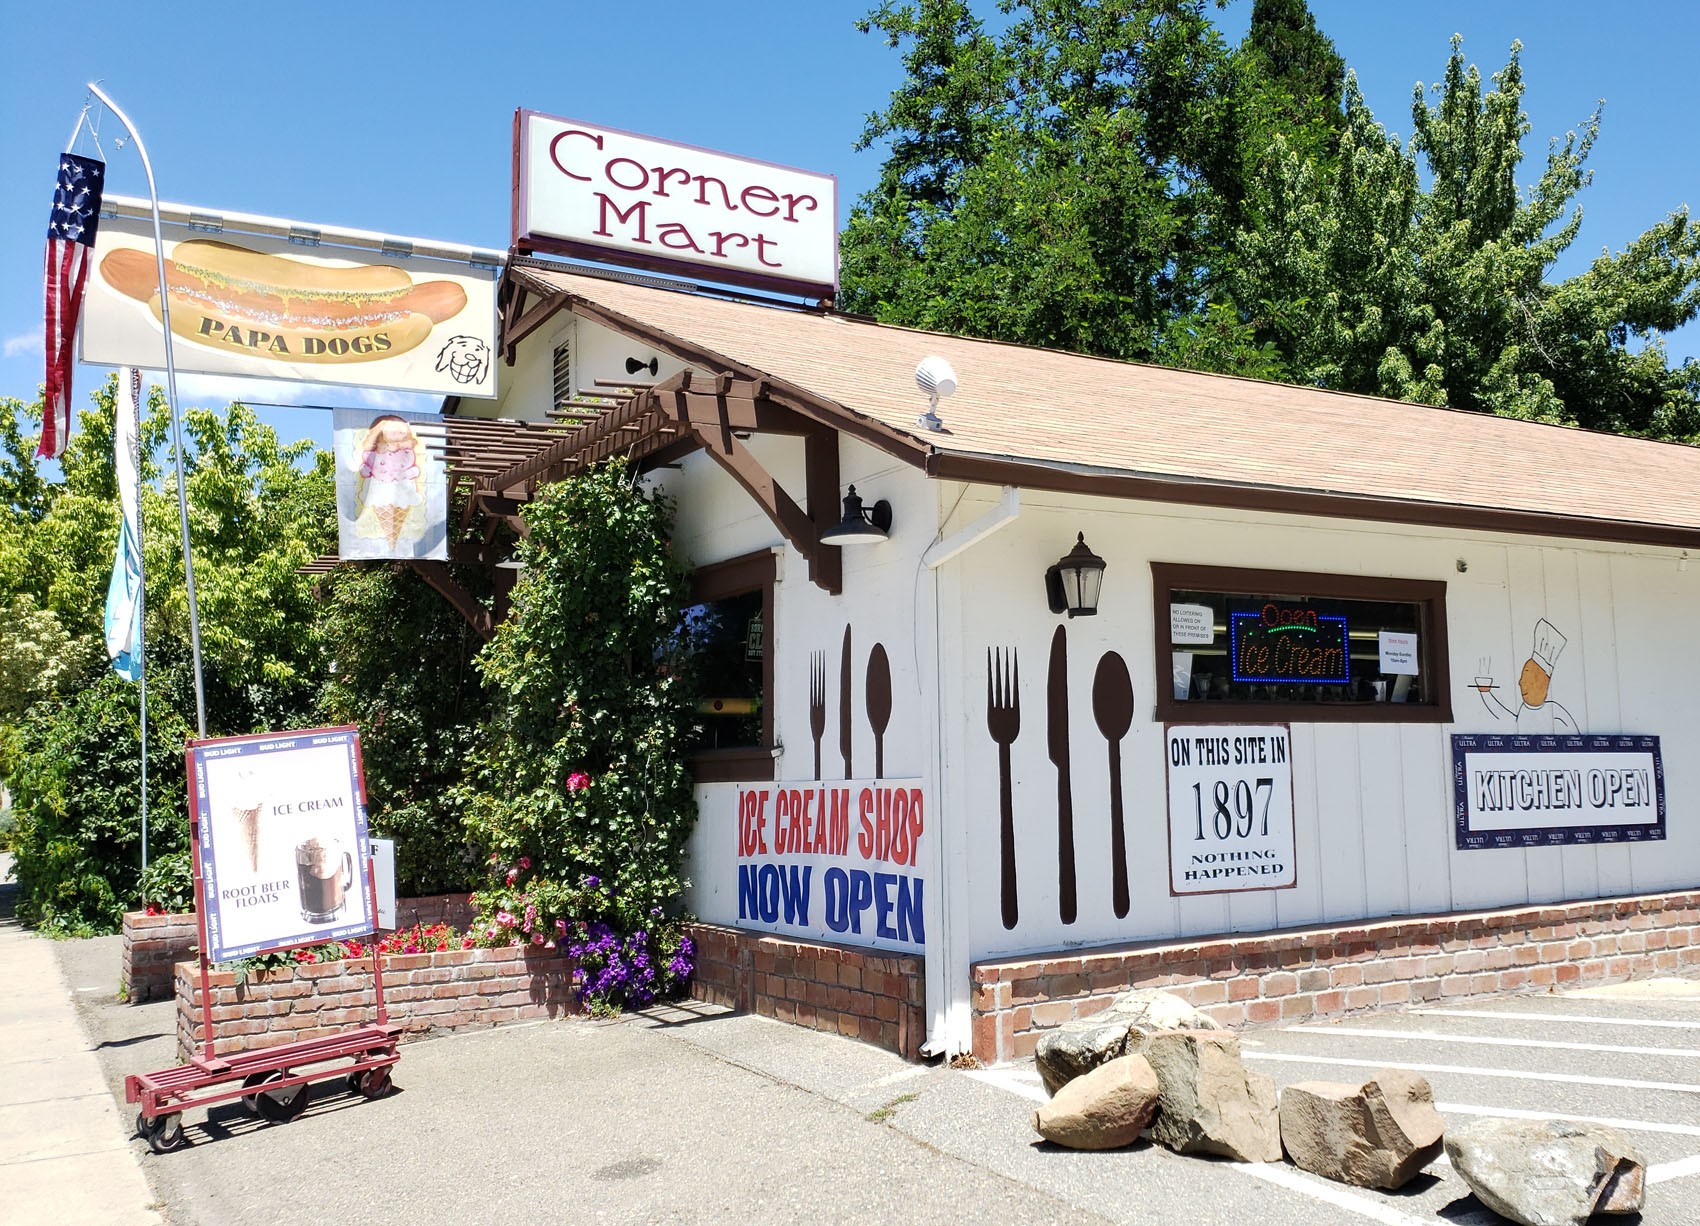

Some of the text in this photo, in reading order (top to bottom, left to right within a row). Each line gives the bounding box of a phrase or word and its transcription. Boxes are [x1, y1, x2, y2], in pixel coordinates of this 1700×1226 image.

[549, 130, 818, 223] Corner
[593, 192, 782, 268] Mart
[197, 316, 392, 357] PAPA DOGS
[1261, 604, 1317, 627] Open
[1239, 635, 1343, 675] Ice Cream
[220, 748, 242, 756] LIGHT
[275, 742, 296, 750] LIGHT
[1171, 736, 1286, 767] ON THIS SITE IN
[1475, 768, 1650, 812] KITCHEN OPEN
[273, 796, 344, 816] ICE CREAM
[1192, 778, 1274, 840] 1897
[738, 788, 924, 866] ICE CREAM SHOP
[1466, 836, 1484, 844] ULTRA
[1192, 850, 1276, 864] NOTHING
[1184, 864, 1284, 881] HAPPENED
[222, 880, 290, 900] ROOT BEER
[236, 894, 279, 908] FLOATS
[738, 864, 926, 944] NOW OPEN
